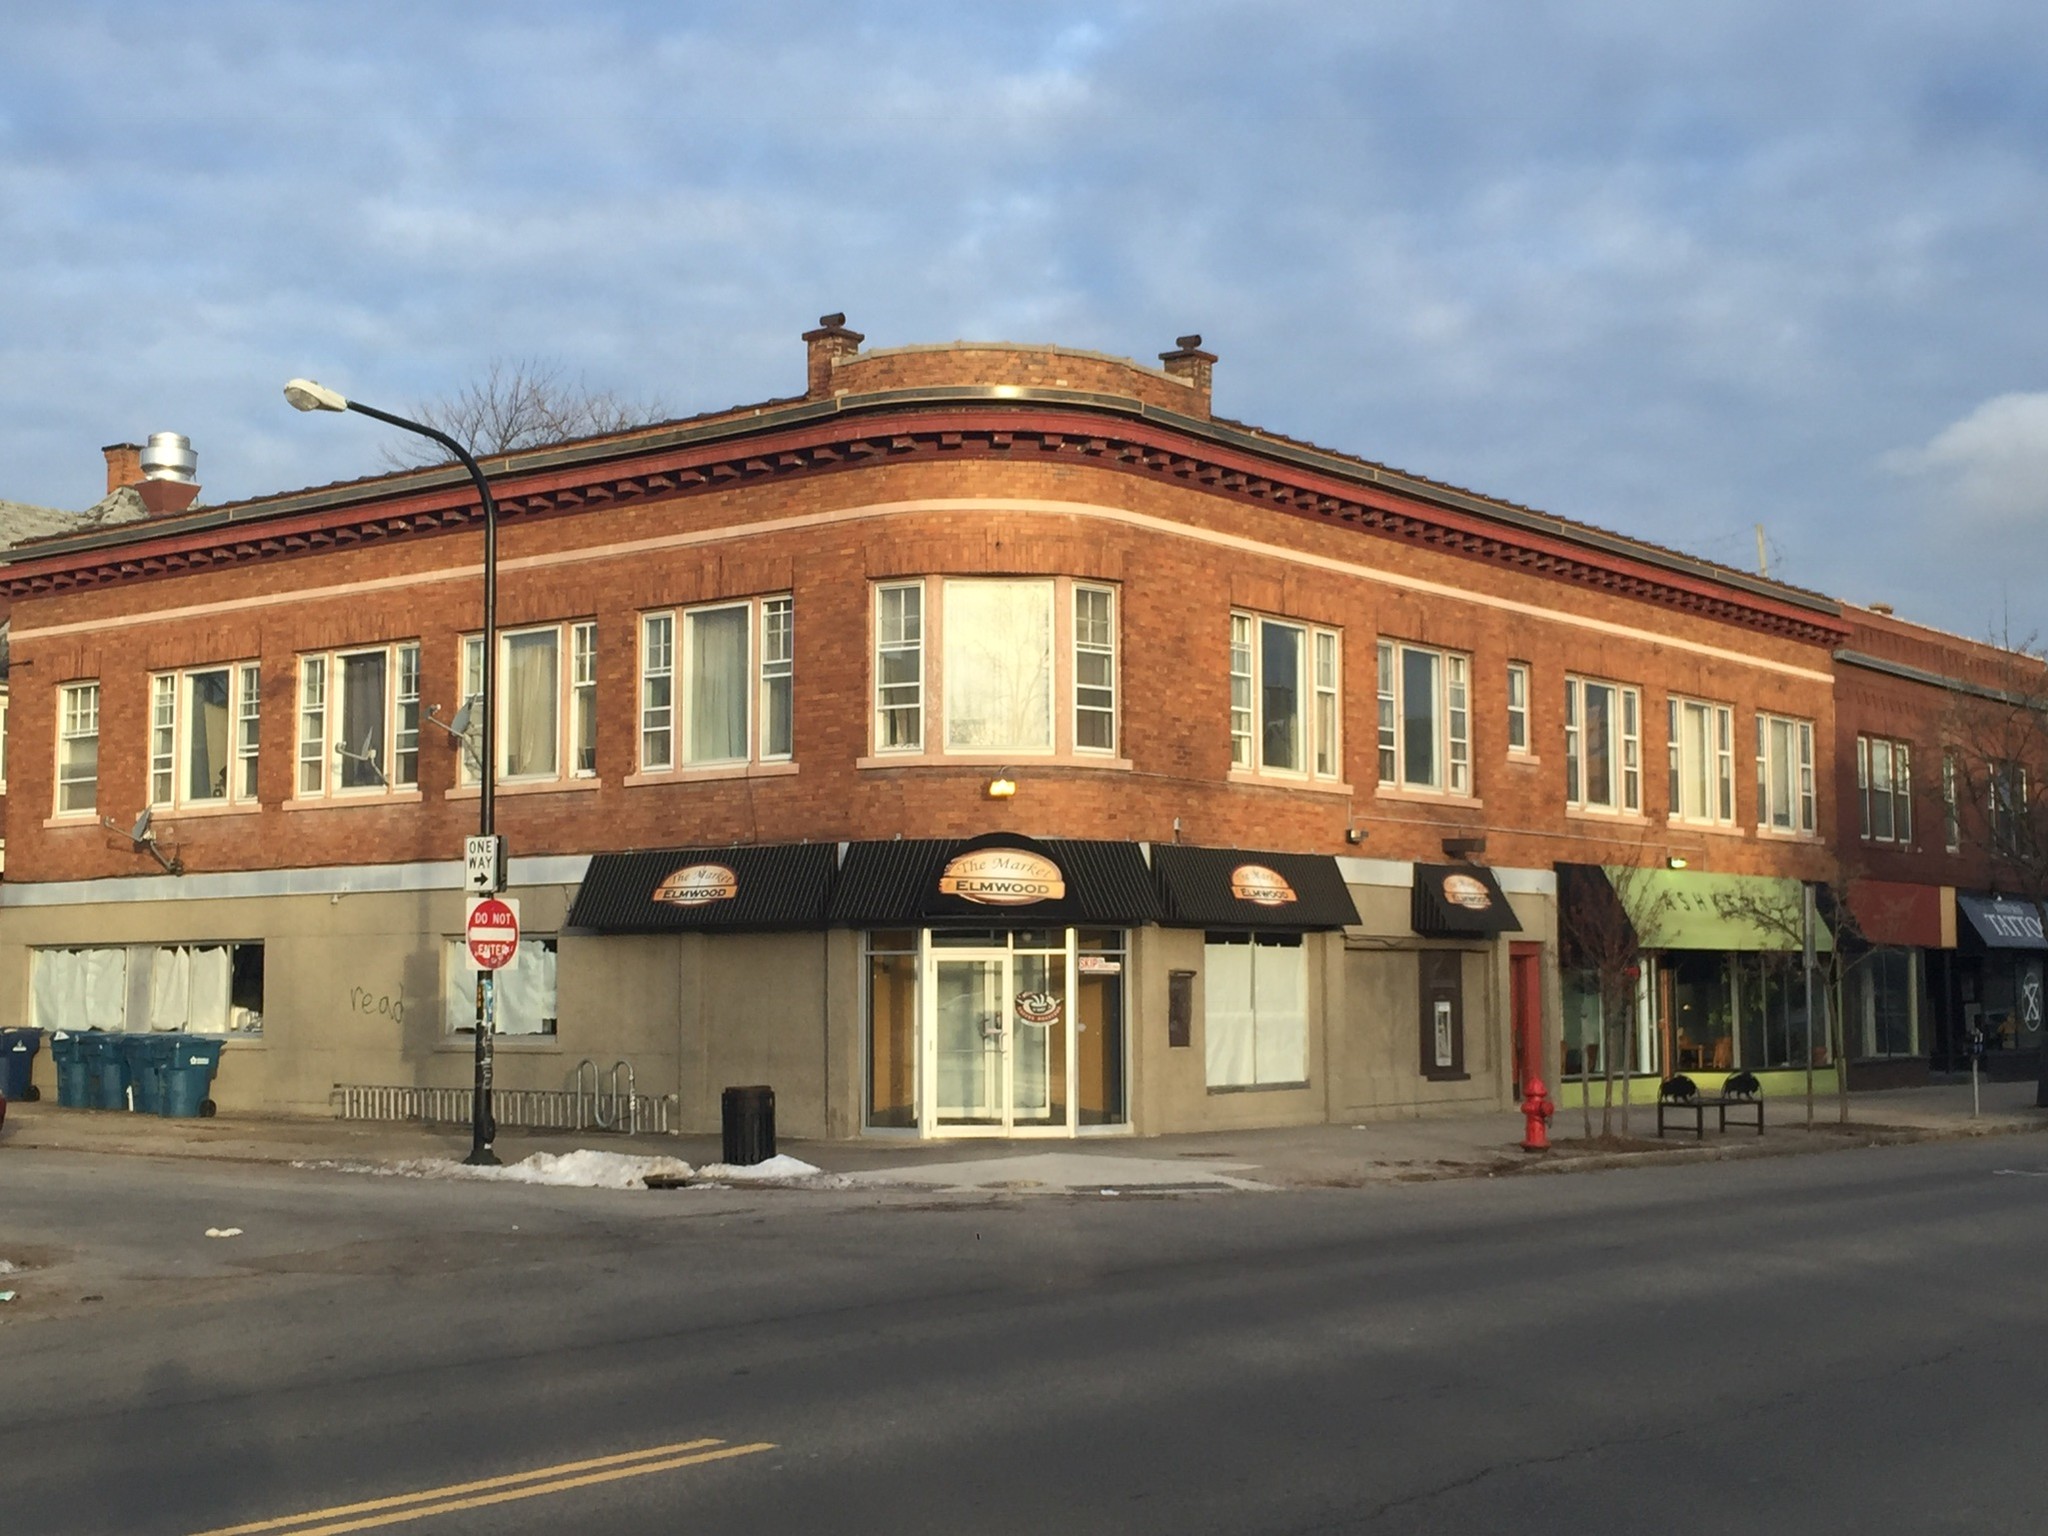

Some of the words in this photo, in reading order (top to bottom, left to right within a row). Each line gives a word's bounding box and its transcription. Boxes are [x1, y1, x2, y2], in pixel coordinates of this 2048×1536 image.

[469, 840, 492, 854] ONE
[469, 856, 493, 870] WAY
[957, 858, 986, 873] The
[991, 857, 1052, 879] Market
[672, 872, 691, 885] The
[694, 869, 733, 884] Market
[662, 888, 727, 899] ELMWOOD
[955, 880, 1050, 895] ELMWOOD
[1240, 887, 1290, 900] ELMWOOD
[475, 912, 488, 925] DO
[492, 912, 512, 925] NOT
[1983, 913, 2044, 939] TATTO
[350, 983, 405, 1024] read
